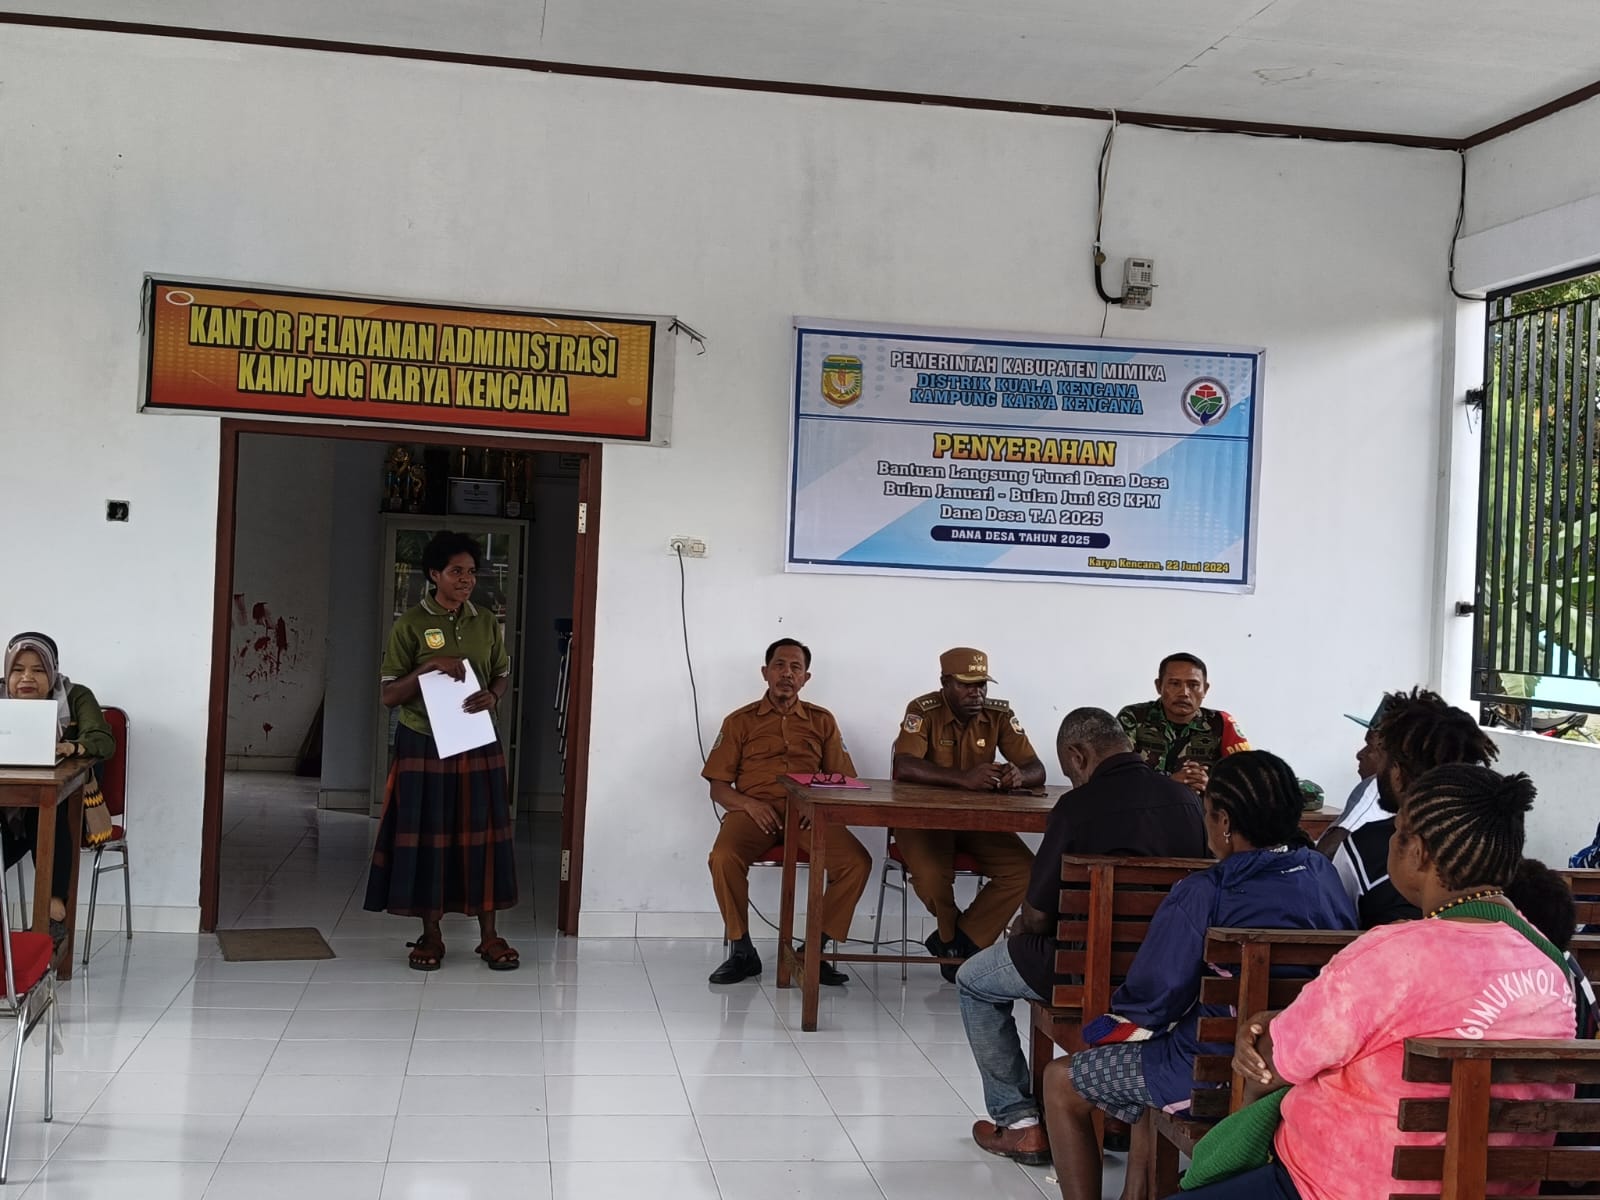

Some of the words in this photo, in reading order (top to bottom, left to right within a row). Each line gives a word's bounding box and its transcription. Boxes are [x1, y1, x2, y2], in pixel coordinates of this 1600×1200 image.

[189, 304, 295, 350] KANTOR
[297, 313, 437, 362] PELAYANAN
[439, 323, 618, 377] ADMINISTRASI
[891, 351, 998, 373] PEMERINTAH
[1002, 357, 1097, 379] KABUPATEN
[1101, 363, 1166, 382] MIMIKA
[237, 351, 367, 401] KAMPUNG
[368, 361, 451, 408] KARYA
[454, 367, 569, 416] KENCANA
[917, 373, 991, 391] DISTRIK
[994, 377, 1053, 395] KUALA
[1057, 380, 1139, 399] KENCANA
[910, 388, 998, 407] KAMPUNG
[1001, 392, 1058, 410] KARYA
[1061, 396, 1144, 415] KENCANA
[933, 432, 1117, 467] PENYERAHAN
[877, 460, 945, 478] Bantuan
[949, 464, 1029, 485] Langsung
[1032, 469, 1081, 485] Tunai
[1084, 471, 1125, 487] Dana
[1128, 473, 1169, 489] Desa
[884, 481, 932, 498] Bulan
[935, 484, 995, 501] Januari
[1009, 488, 1058, 504] Bulan
[1061, 490, 1095, 506] Juni
[1097, 492, 1120, 508] 36
[1123, 493, 1162, 509] KPM
[940, 504, 982, 521] Dana
[985, 506, 1026, 523] Desa
[1028, 508, 1057, 524] T.A
[1059, 510, 1103, 526] 2025
[951, 529, 982, 540] DANA
[985, 530, 1015, 541] DESA
[1018, 532, 1057, 543] TAHUN
[1060, 534, 1090, 545] 2025
[1088, 556, 1117, 570] Karya
[1118, 558, 1164, 571] Kencana,
[1165, 560, 1180, 571] 22
[1181, 561, 1201, 572] Juni
[1203, 562, 1230, 573] 2024
